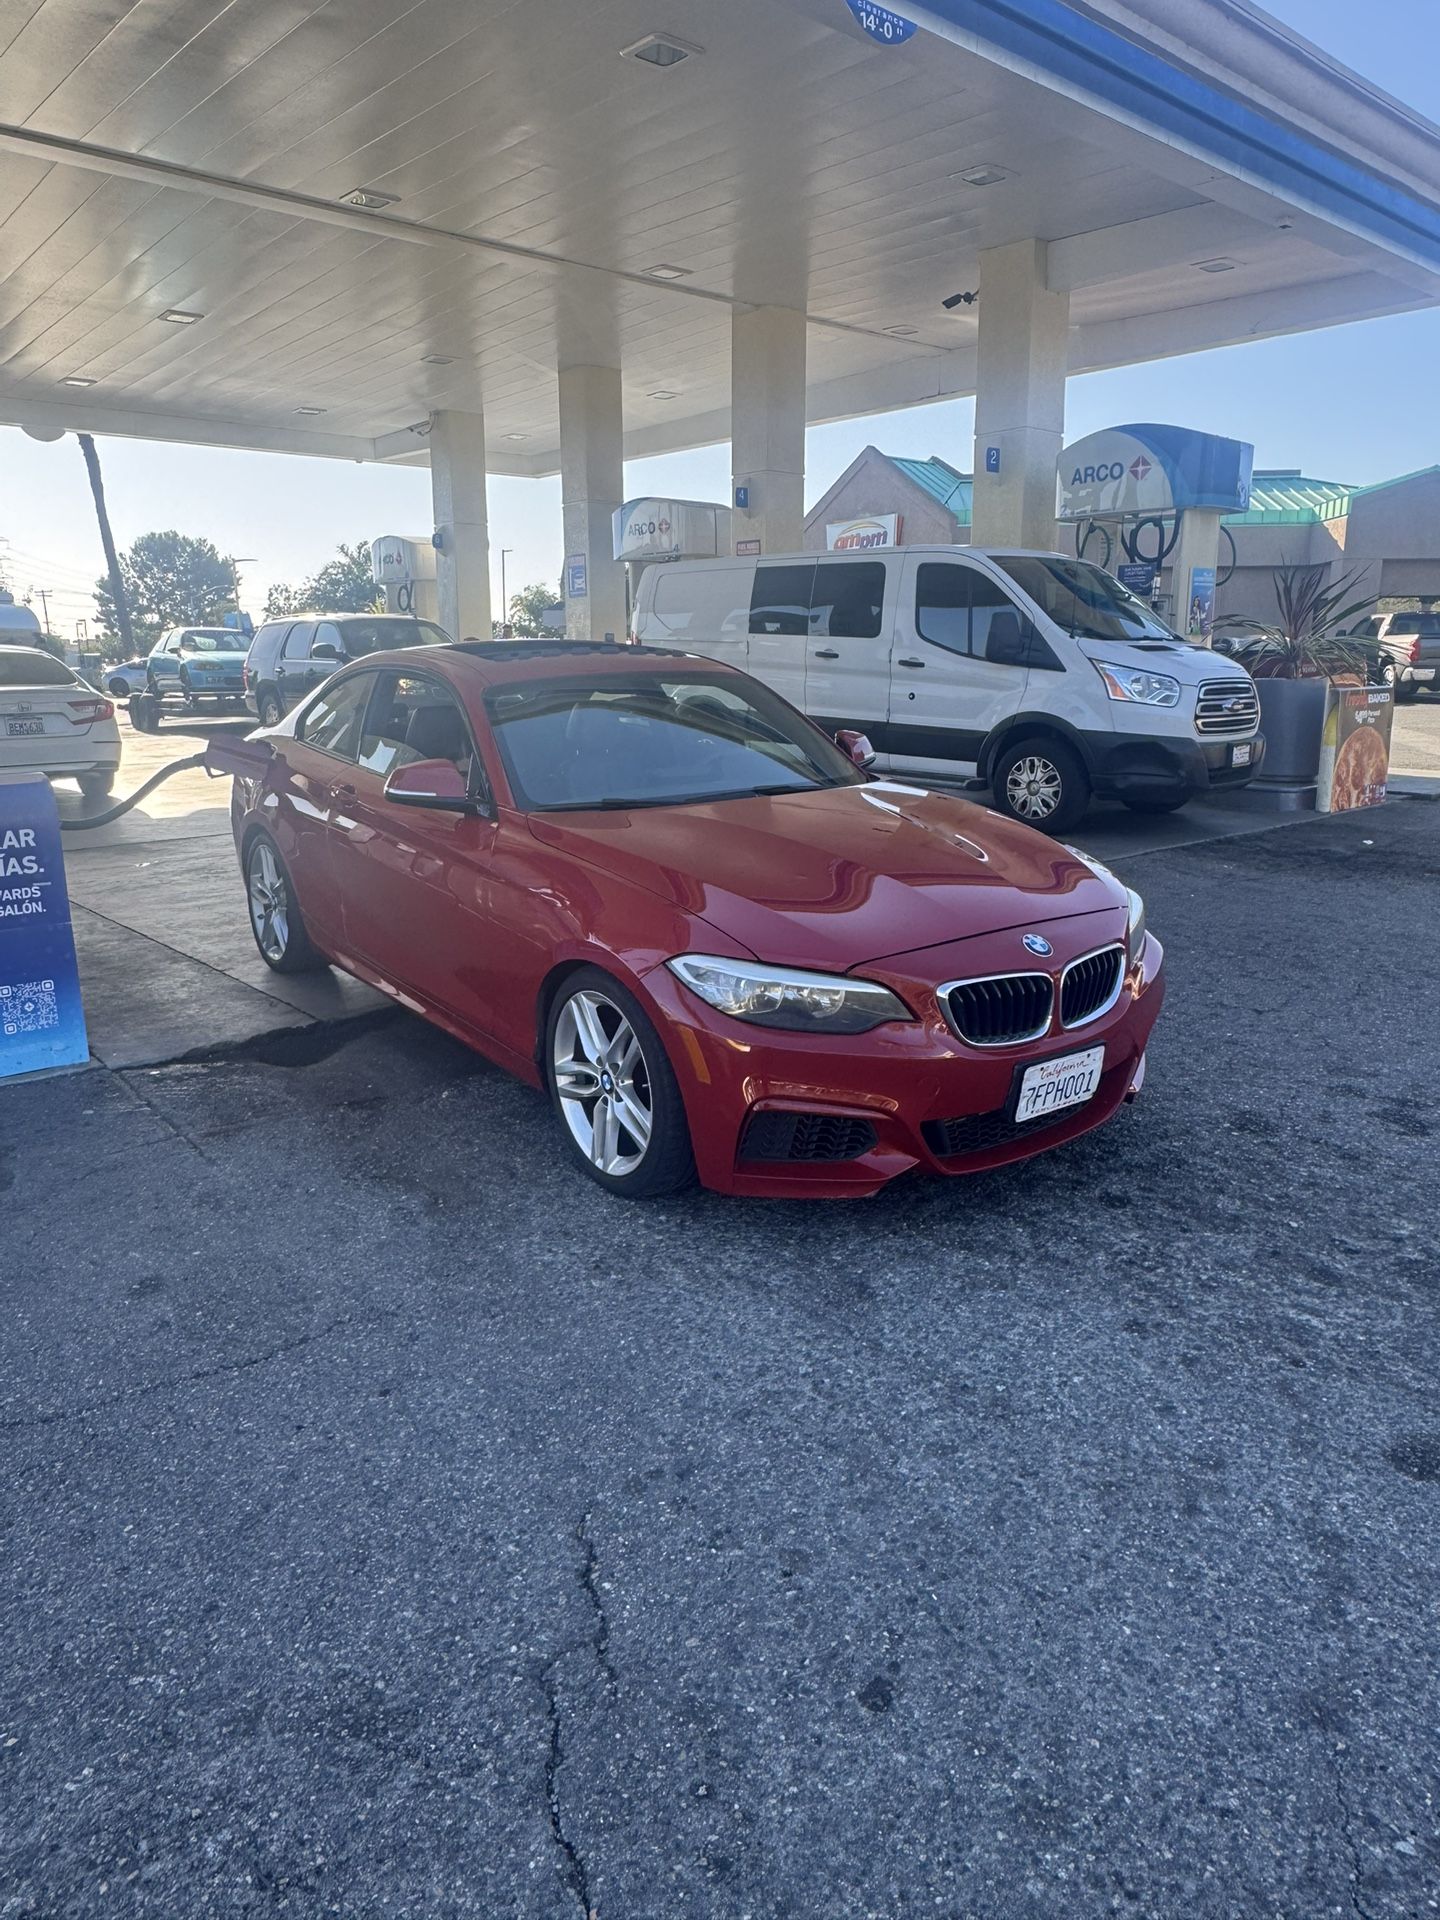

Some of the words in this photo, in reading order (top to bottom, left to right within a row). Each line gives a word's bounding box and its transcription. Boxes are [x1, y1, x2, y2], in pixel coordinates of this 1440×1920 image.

[857, 0, 904, 27] clearance
[990, 450, 997, 464] 2
[1071, 462, 1124, 486] ARCO
[738, 489, 745, 500] 4
[628, 521, 656, 537] ARCO
[833, 530, 888, 550] ampm
[1368, 692, 1391, 704] BAKED
[0, 828, 36, 850] AR
[0, 886, 42, 902] ARDS
[1040, 1059, 1089, 1081] California
[1025, 1068, 1095, 1113] 7FPH001
